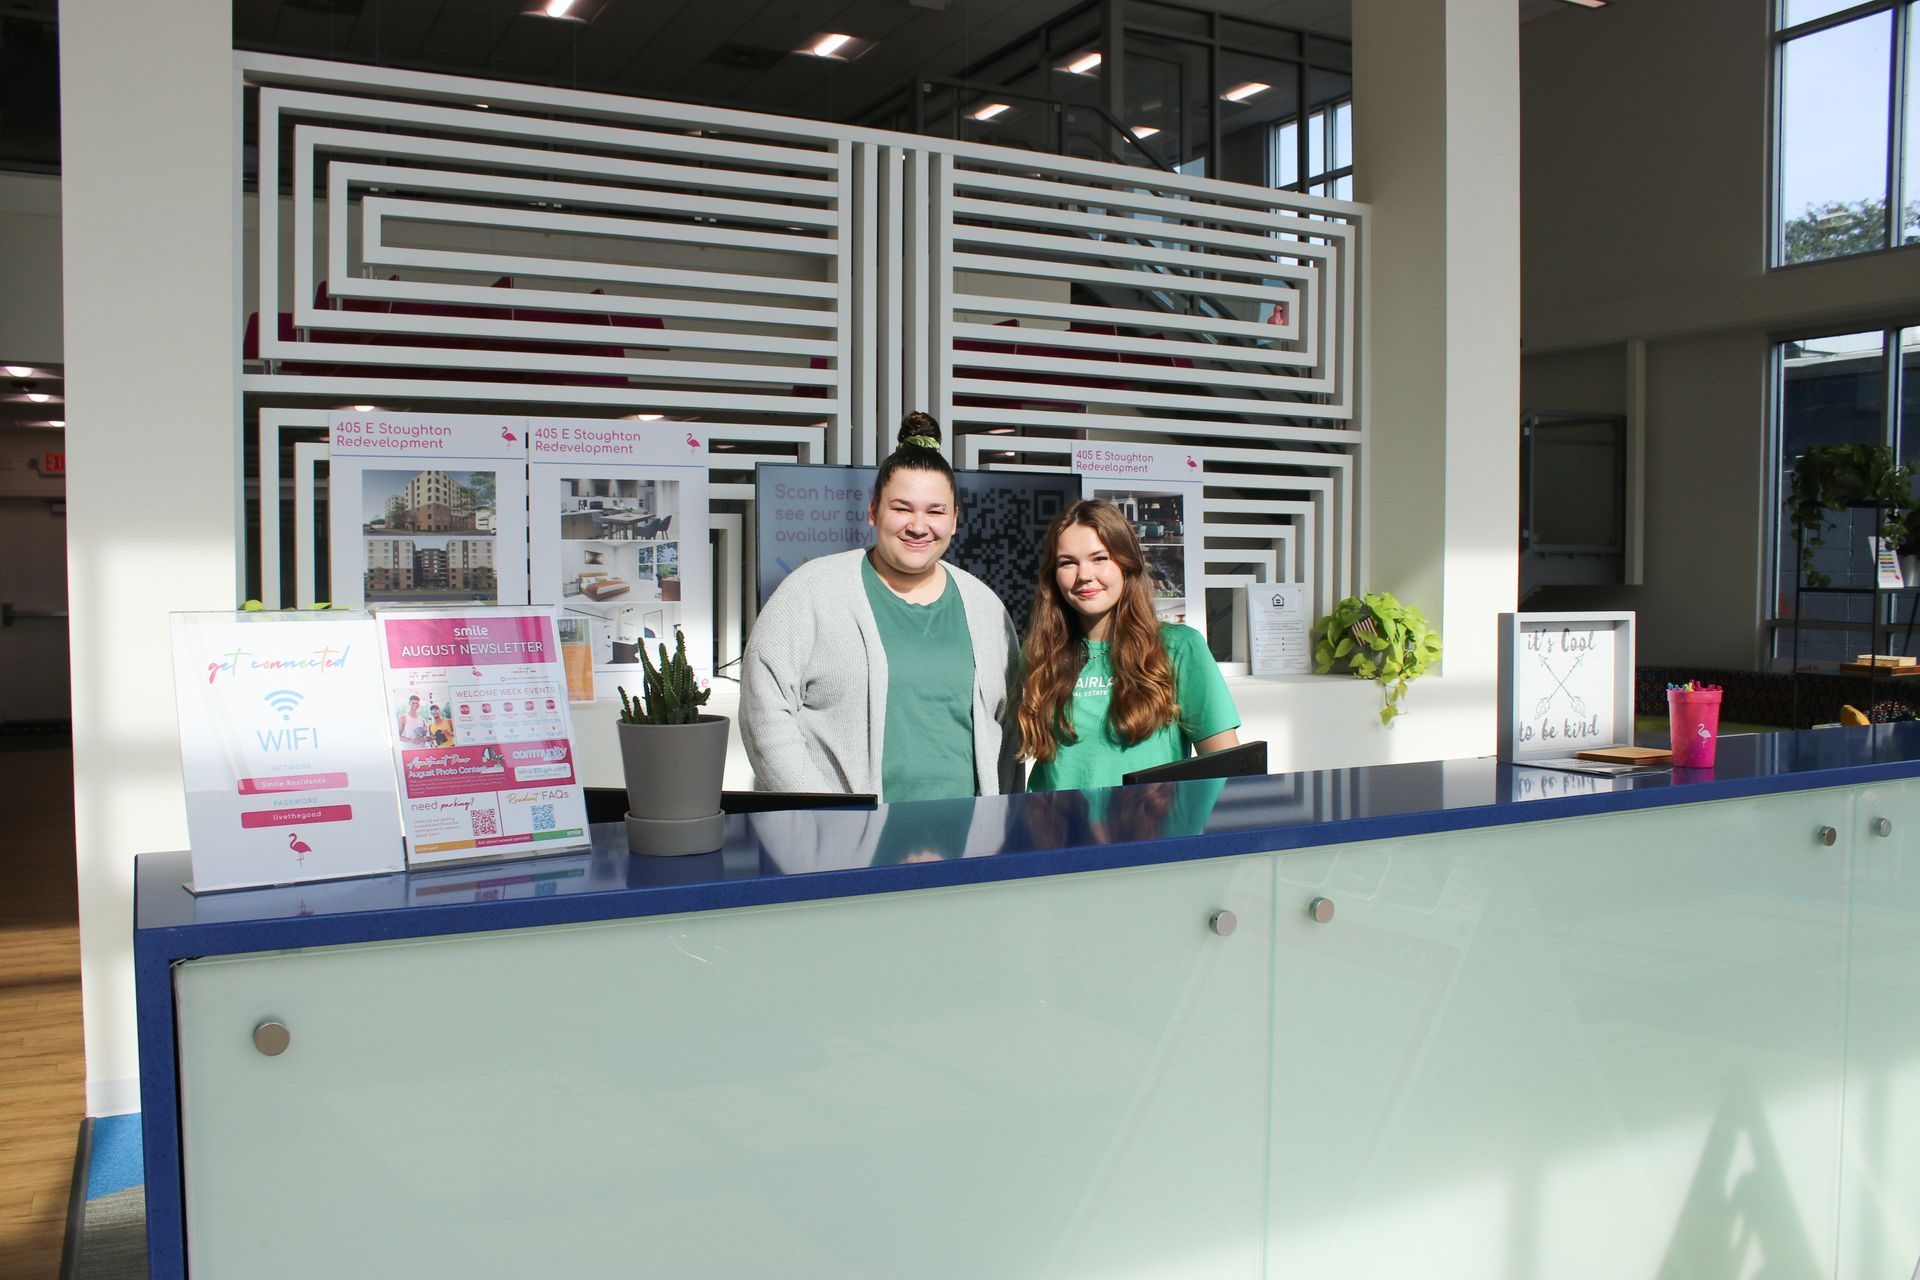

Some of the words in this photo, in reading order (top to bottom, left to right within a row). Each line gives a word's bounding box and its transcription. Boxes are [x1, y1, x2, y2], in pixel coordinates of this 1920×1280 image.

[336, 422, 361, 434] 405
[366, 422, 374, 434] E
[379, 423, 452, 437] Stoughton
[535, 428, 558, 440] 405
[562, 428, 570, 440] E
[574, 429, 641, 443] Stoughton
[336, 435, 444, 450] Redevelopment
[535, 441, 633, 455] Redevelopment
[45, 453, 65, 472] EXI
[1076, 450, 1093, 460] 405
[1096, 451, 1102, 460] E
[1105, 451, 1154, 464] Stoughton
[1076, 461, 1148, 474] Redevelopment
[775, 483, 819, 500] Scan
[825, 484, 863, 500] here
[776, 508, 804, 521] see
[810, 509, 840, 521] our
[775, 527, 873, 546] availability!
[454, 625, 488, 636] smile
[1528, 629, 1555, 653] it's
[1561, 628, 1597, 652] Cool
[401, 643, 456, 657] AUGUST
[460, 642, 543, 655] NEWSLETTER
[208, 648, 252, 685] get
[251, 645, 351, 674] connected
[456, 689, 497, 698] WELCOME
[500, 688, 521, 696] WEEK
[524, 686, 555, 695] EVENTS
[1519, 719, 1536, 742] to
[1541, 718, 1559, 741] be
[1563, 714, 1600, 739] kind
[256, 727, 319, 752] WIFI
[272, 763, 312, 772] NETWORK
[409, 769, 435, 778] August
[436, 767, 458, 776] Photo
[261, 780, 284, 788] Smile
[286, 778, 327, 787] Residents
[541, 790, 569, 800] FAQs
[273, 798, 318, 807] PASSWORD
[411, 800, 438, 811] need
[440, 797, 475, 812] parking?
[272, 811, 322, 821] livethegood
